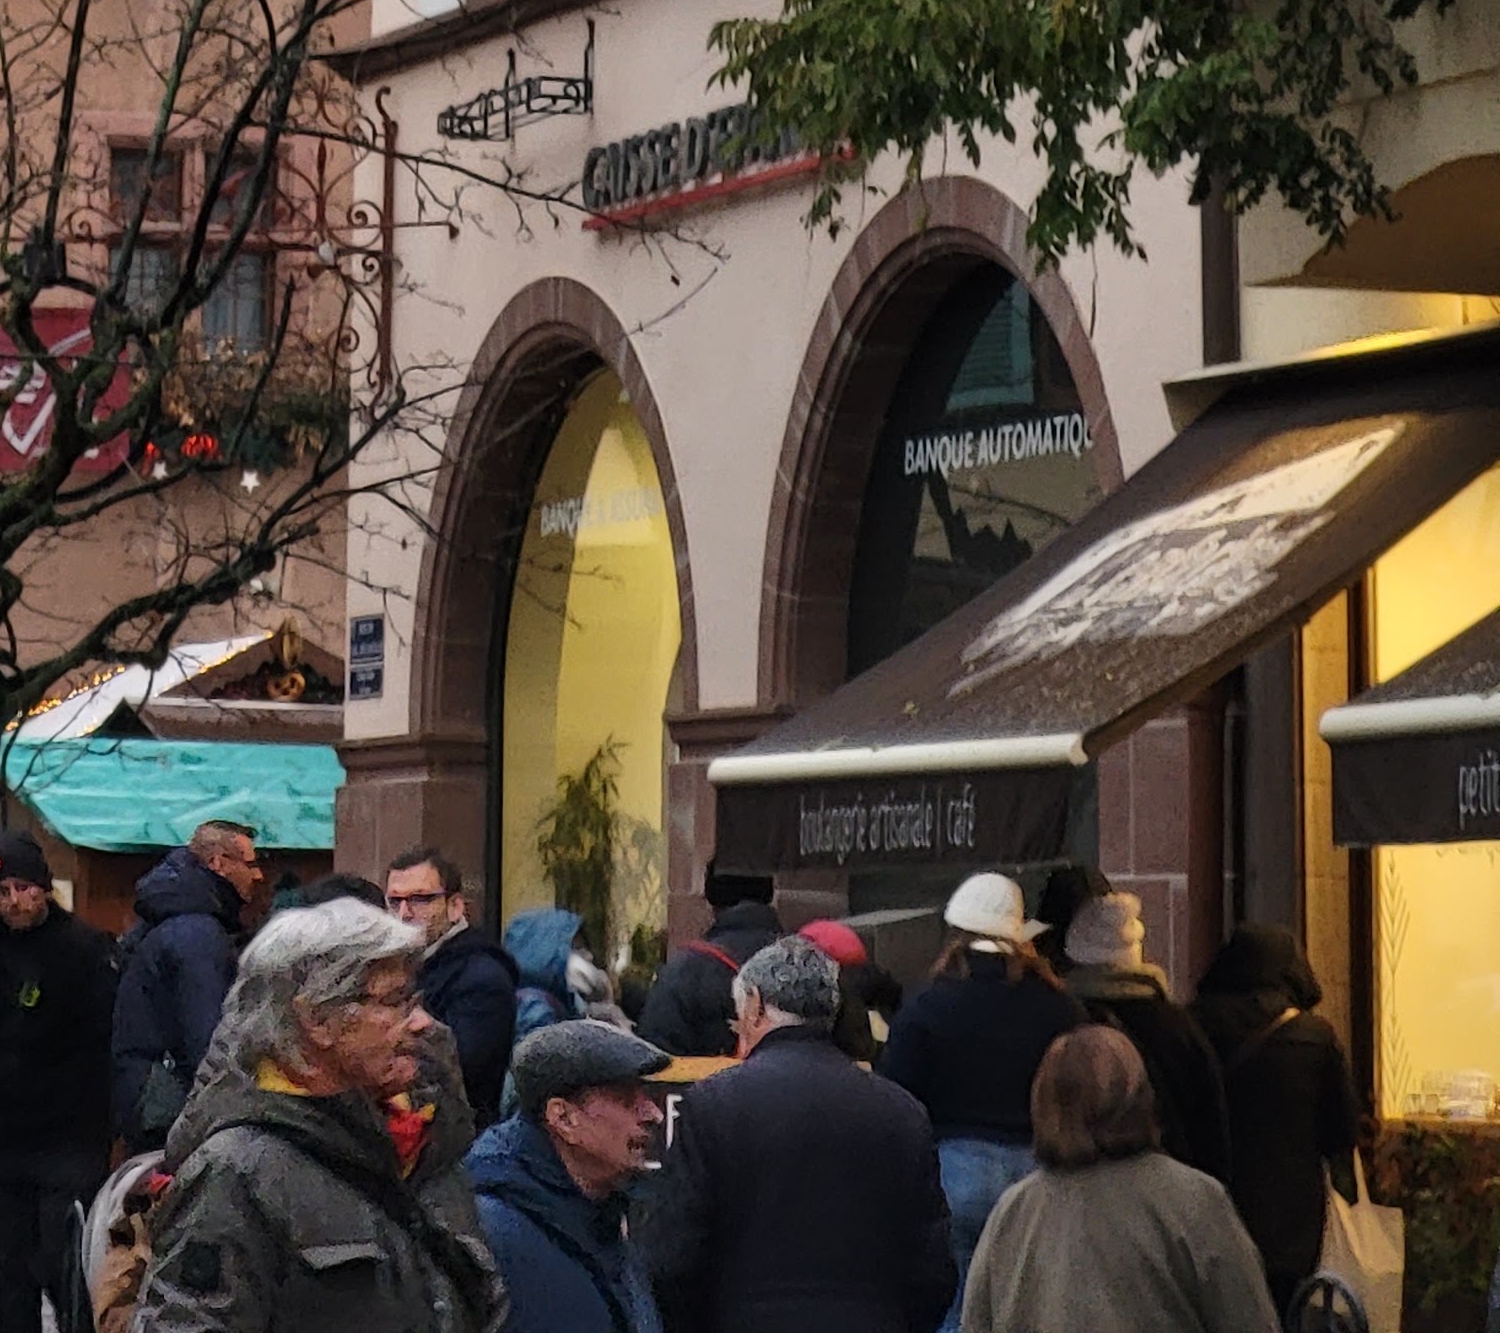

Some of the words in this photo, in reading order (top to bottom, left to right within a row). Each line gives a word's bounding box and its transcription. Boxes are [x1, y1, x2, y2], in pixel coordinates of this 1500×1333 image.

[905, 430, 975, 481] BANQUE
[800, 791, 867, 866] boulangerie
[870, 783, 933, 851] artisanale
[946, 782, 975, 848] café
